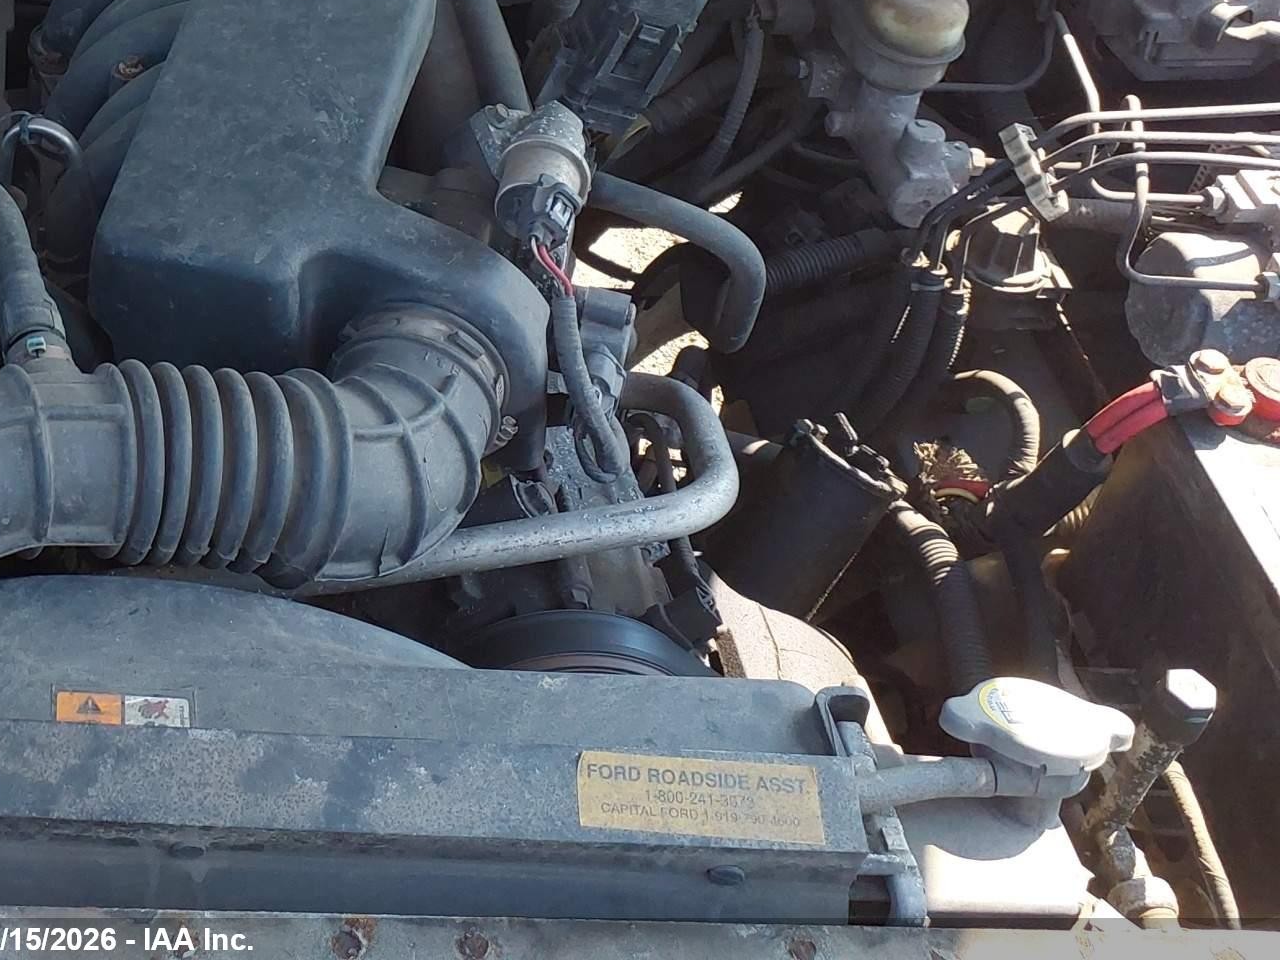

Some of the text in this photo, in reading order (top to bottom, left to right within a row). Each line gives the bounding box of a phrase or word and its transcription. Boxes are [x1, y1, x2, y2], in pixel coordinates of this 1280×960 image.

[586, 763, 641, 782] FORD
[647, 768, 751, 792] ROADSIDE
[600, 802, 657, 817] CAPITAL
[661, 807, 699, 820] FORD
